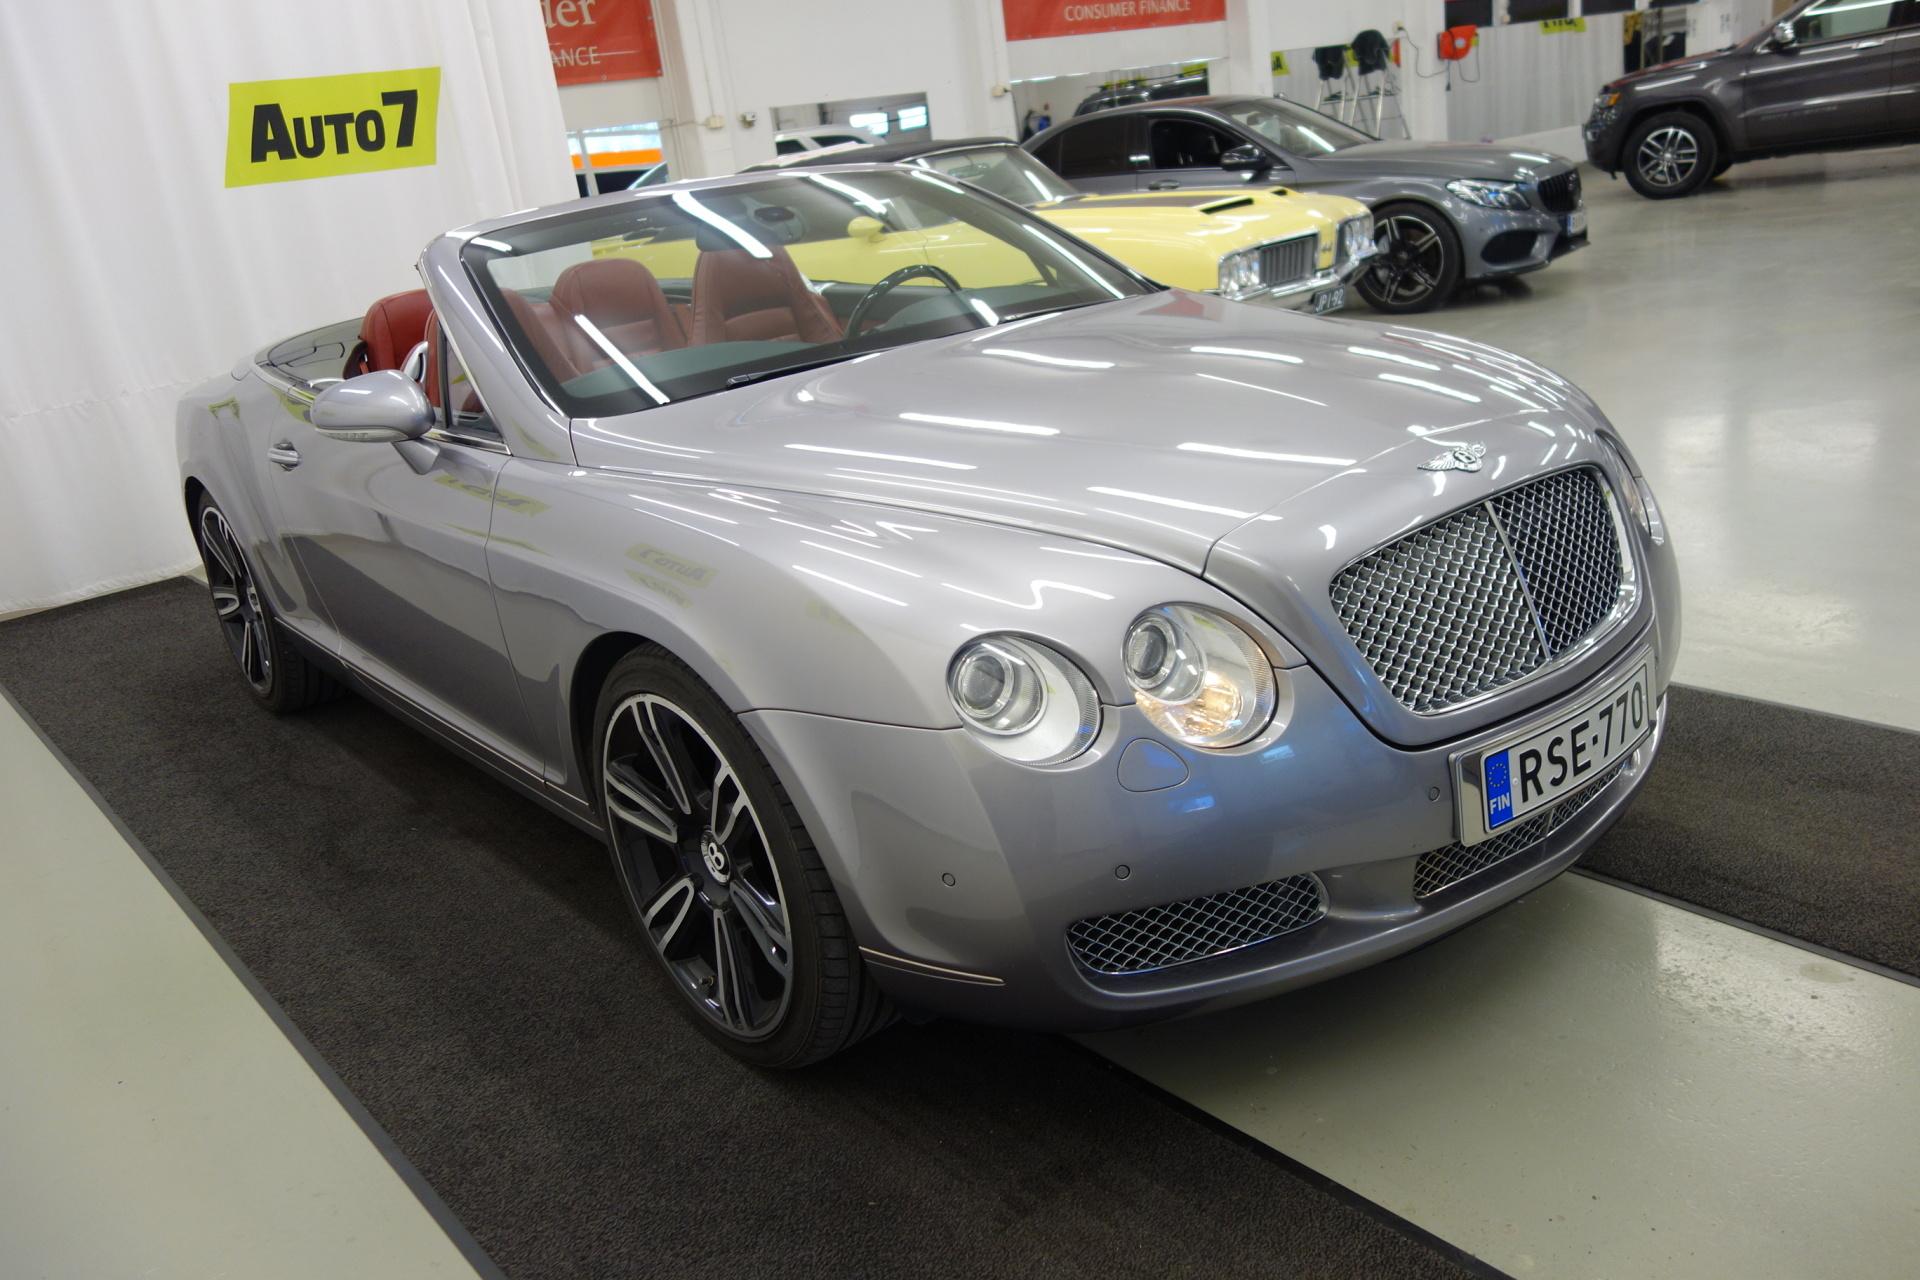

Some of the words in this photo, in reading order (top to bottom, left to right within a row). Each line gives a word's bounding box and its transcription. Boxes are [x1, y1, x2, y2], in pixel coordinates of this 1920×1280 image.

[1064, 2, 1136, 21] CONSUMER
[1140, 0, 1191, 15] FINANCE
[1519, 681, 1643, 803] RSE-770
[1489, 792, 1511, 815] FIN
